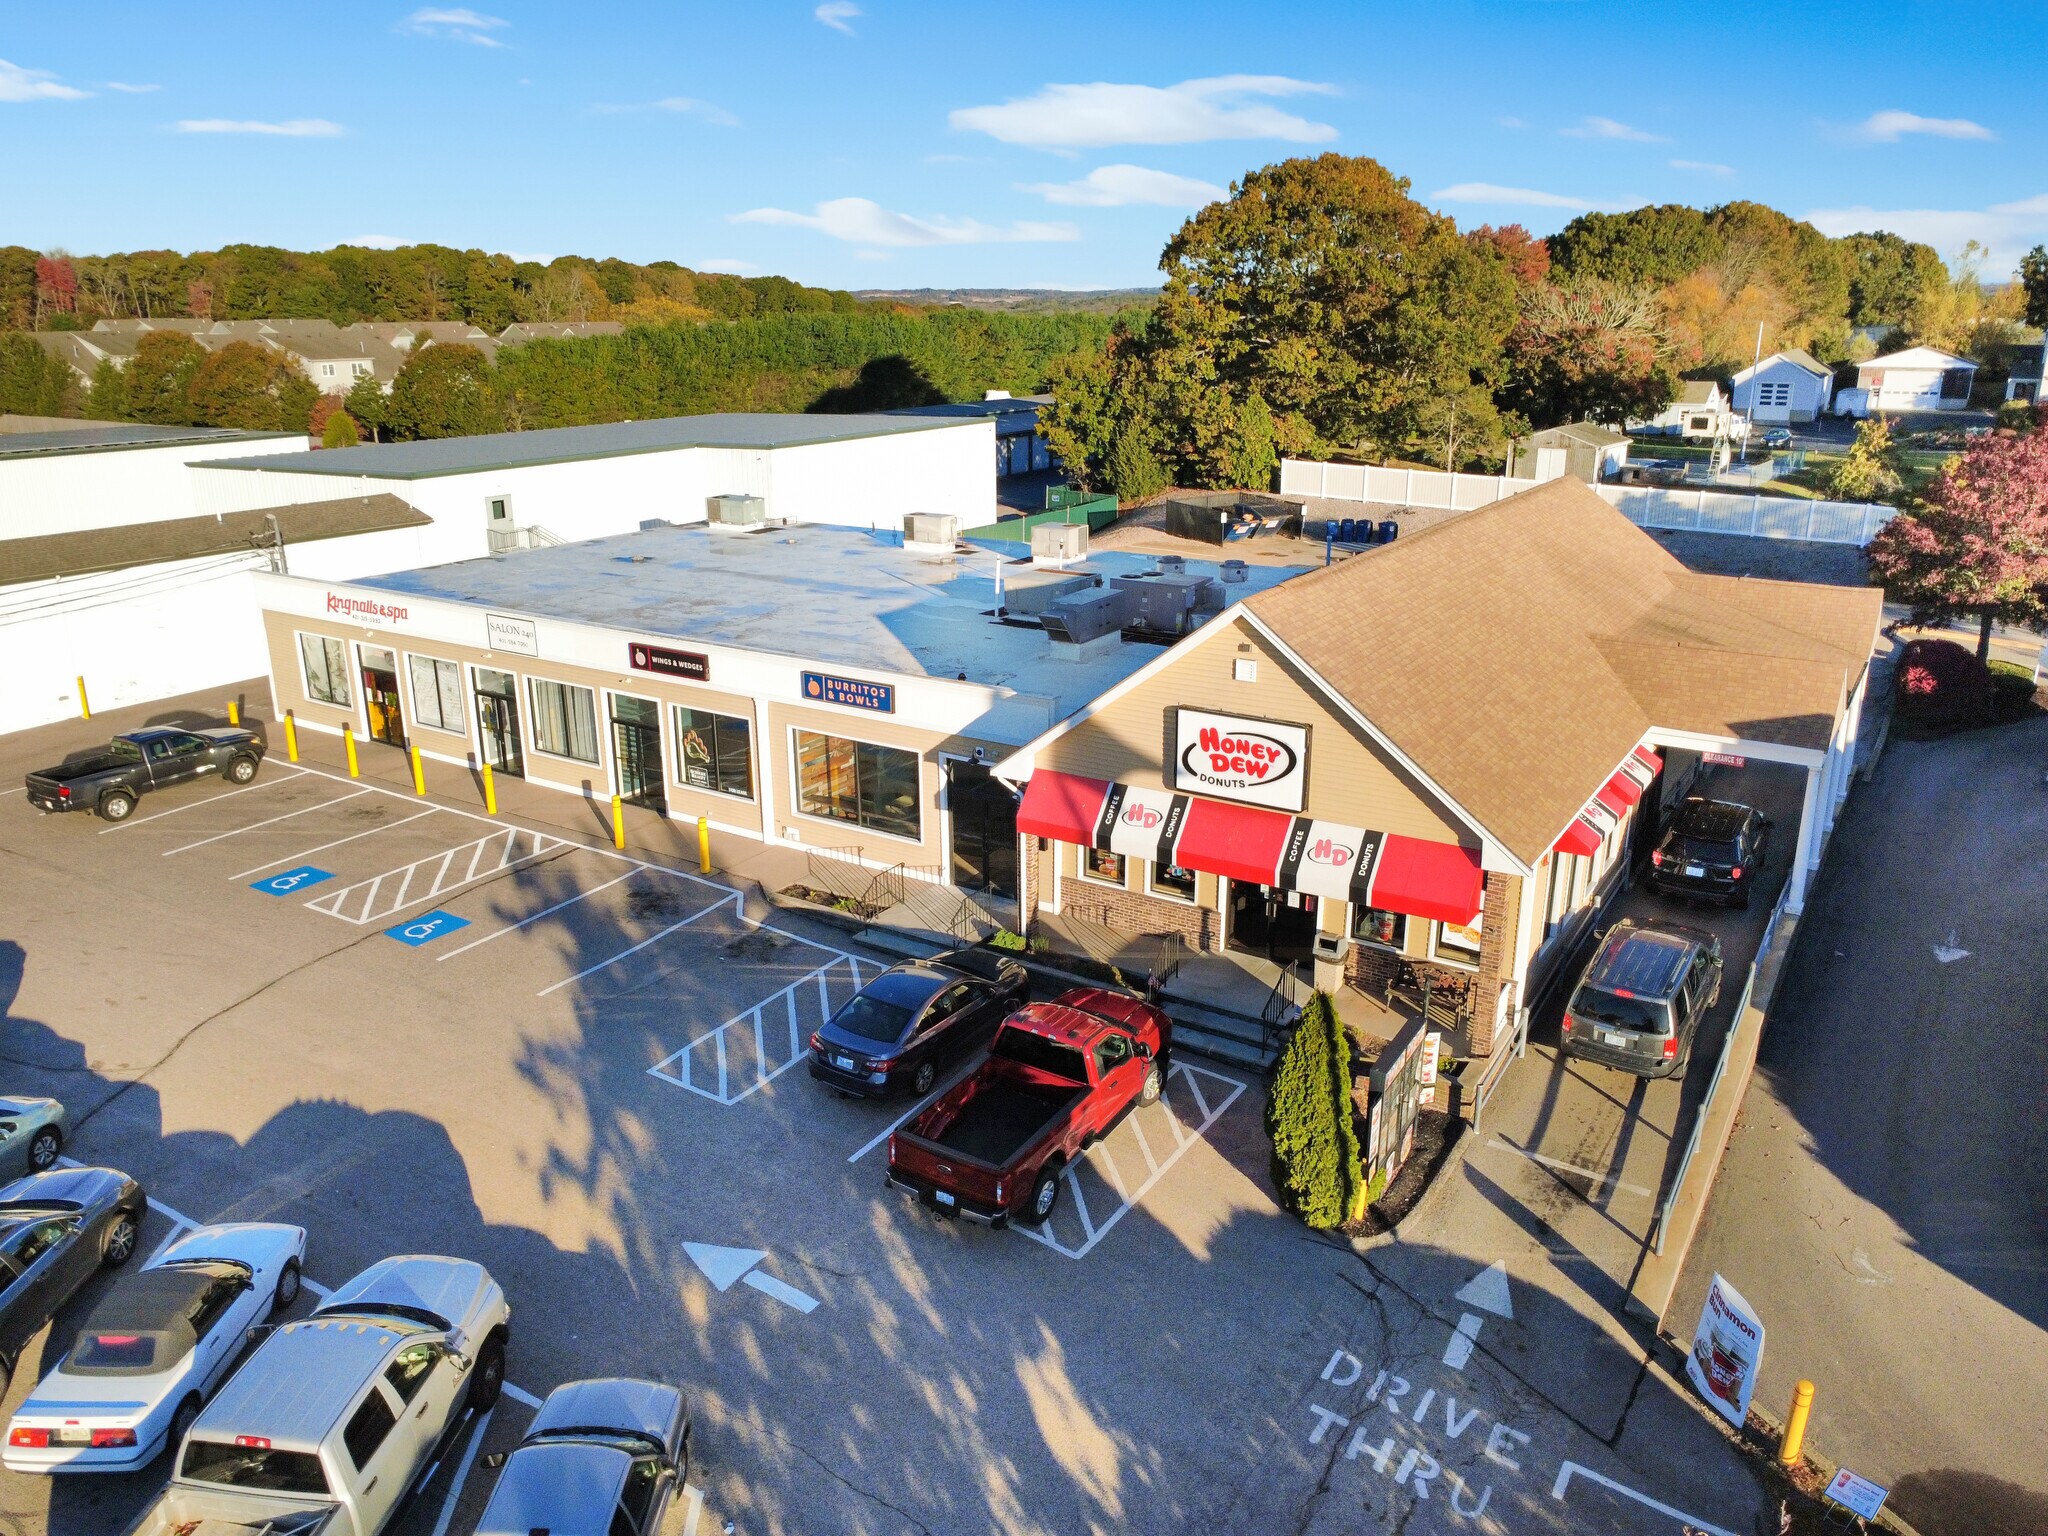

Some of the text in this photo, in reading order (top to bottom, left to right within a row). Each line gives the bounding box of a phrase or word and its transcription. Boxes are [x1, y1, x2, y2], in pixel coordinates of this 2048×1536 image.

[490, 622, 520, 635] SALON
[652, 656, 672, 666] WINGS
[678, 661, 703, 671] WEDGES
[828, 680, 886, 698] BURRITOS
[828, 690, 879, 707] & BOWLS
[1200, 728, 1280, 763] HONEY
[1704, 752, 1734, 765] CLEARANCE
[1209, 754, 1269, 778] DEW
[1200, 774, 1246, 788] DONUTS
[1105, 795, 1120, 825] COFFEE
[1128, 804, 1157, 828] HD
[1166, 807, 1180, 838] DONUTS
[1289, 830, 1304, 862] COFFEE
[1315, 839, 1347, 866] HD
[1358, 843, 1374, 876] DONUTS
[1709, 1293, 1721, 1320] Bun
[1712, 1284, 1756, 1341] Cinnamon
[1320, 1350, 1531, 1471] DRIVE
[1308, 1403, 1493, 1519] THRU
